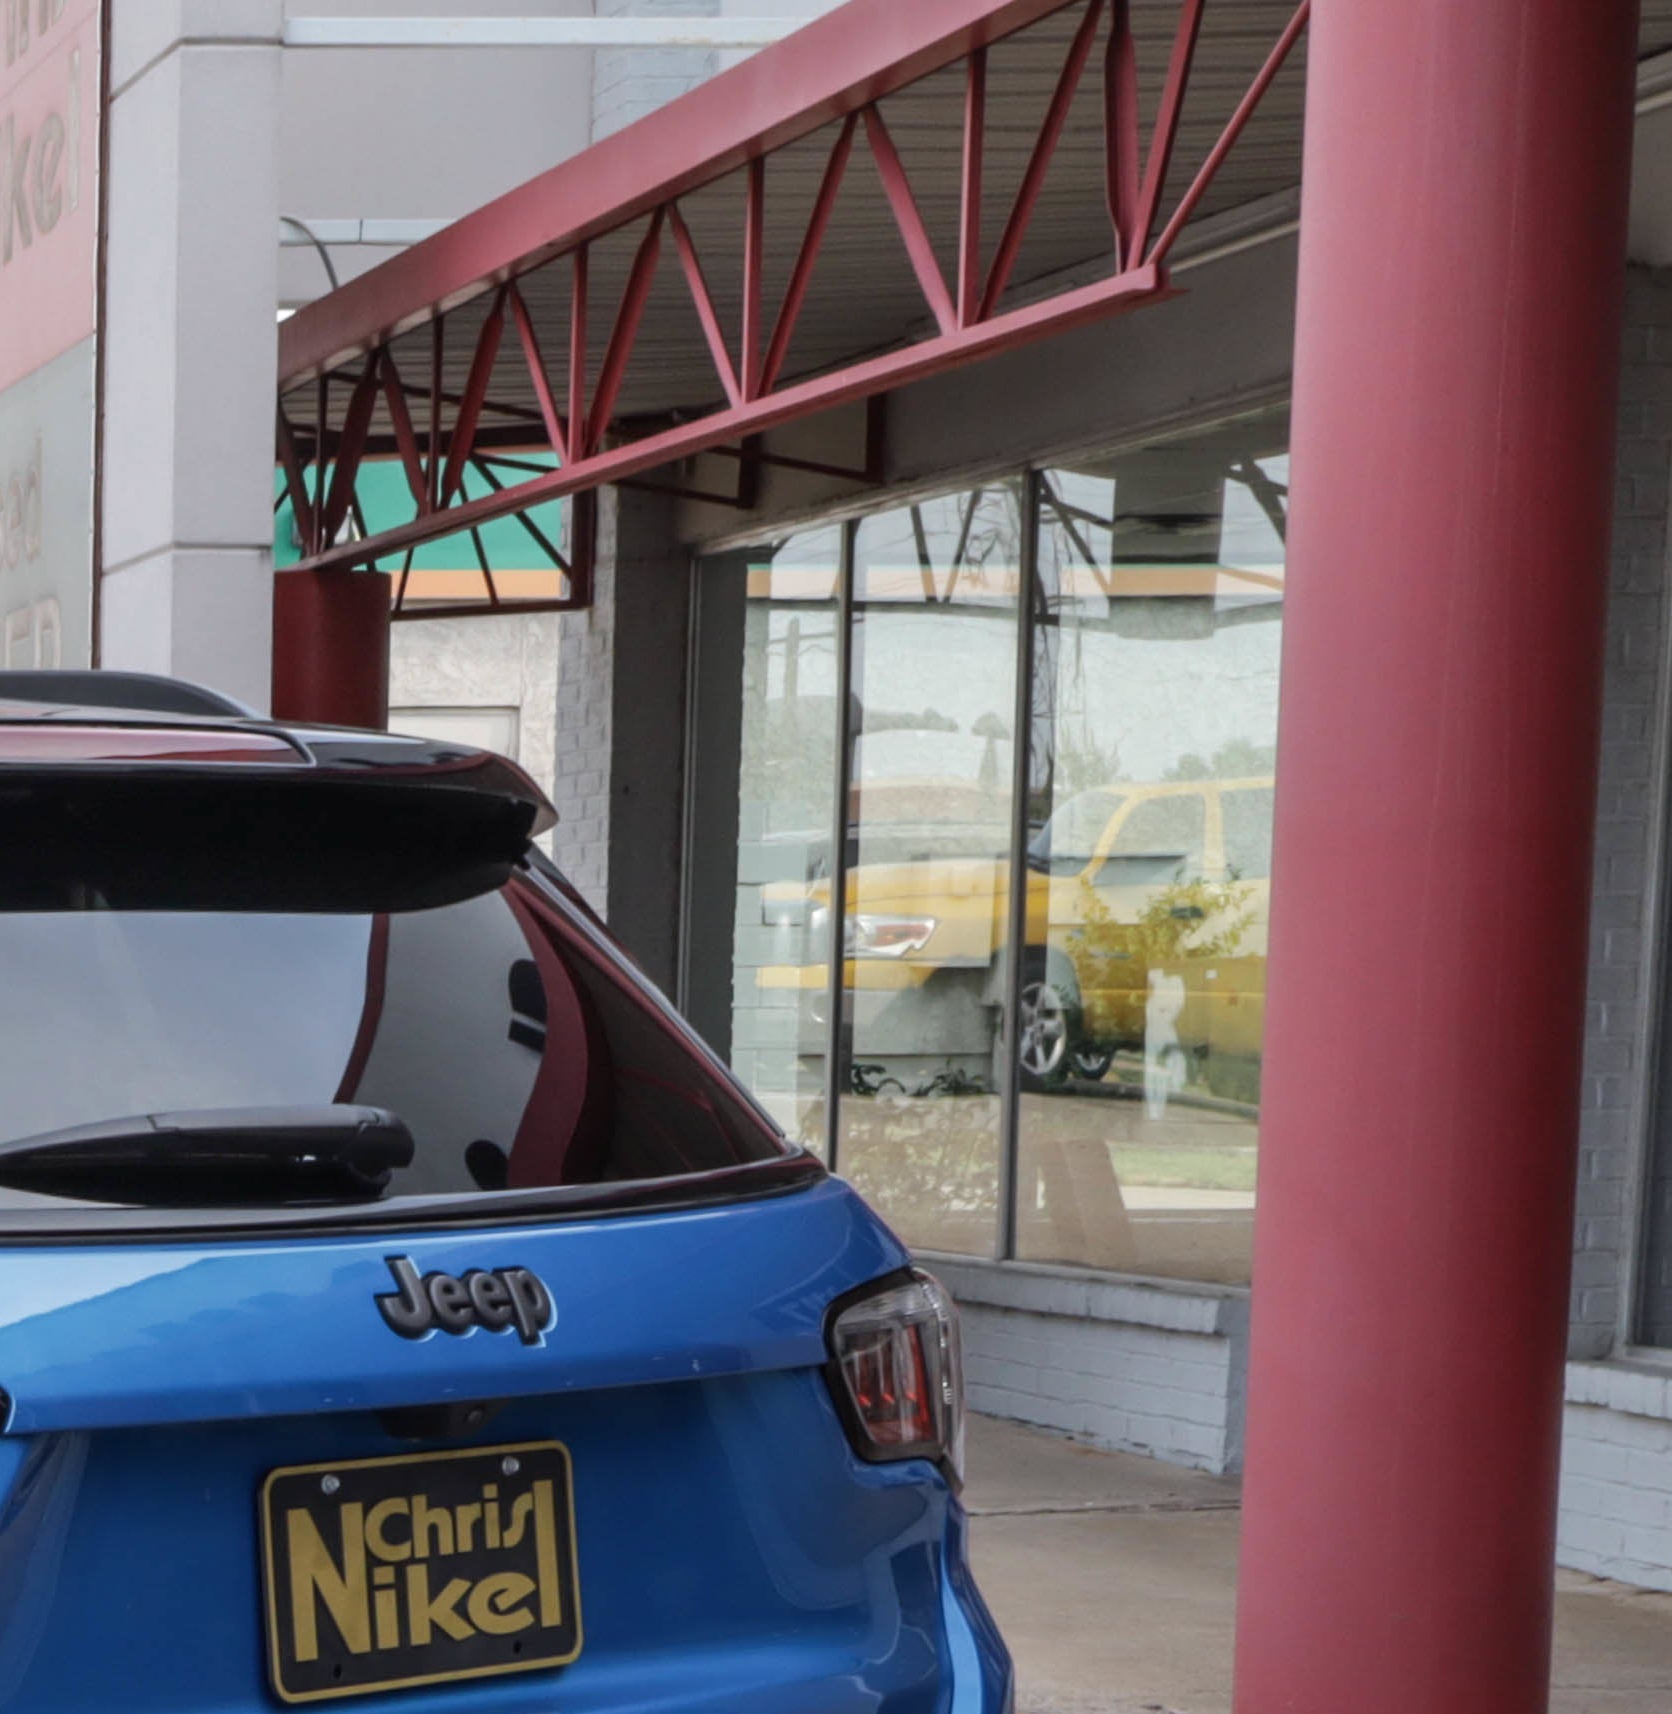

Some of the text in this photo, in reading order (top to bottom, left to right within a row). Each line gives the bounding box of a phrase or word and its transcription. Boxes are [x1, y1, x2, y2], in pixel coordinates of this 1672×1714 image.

[373, 1254, 554, 1346] Jeep
[365, 1482, 533, 1562] Chris
[287, 1480, 562, 1662] Nikel
